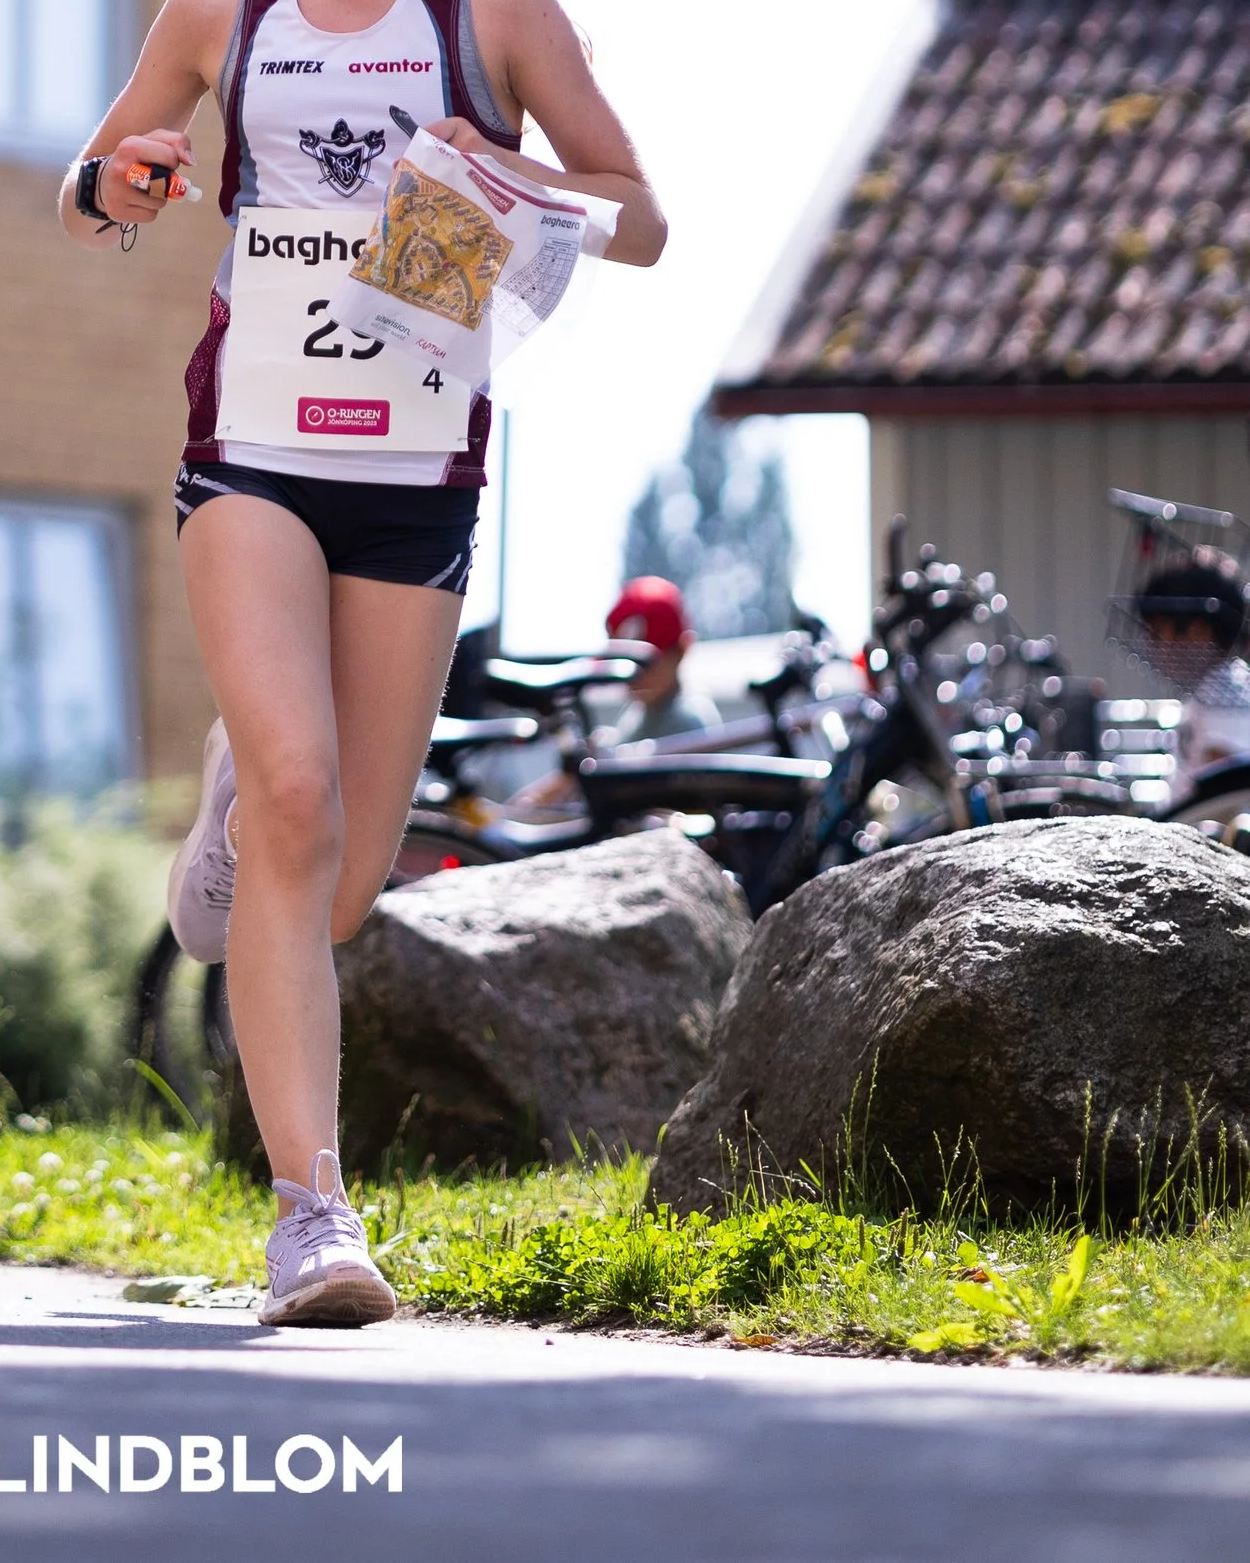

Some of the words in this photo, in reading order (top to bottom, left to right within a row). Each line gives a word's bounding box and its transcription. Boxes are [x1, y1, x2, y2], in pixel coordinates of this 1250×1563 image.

[259, 60, 325, 75] TRIMTEX
[348, 58, 434, 74] avantor
[540, 215, 580, 231] bagheera
[248, 227, 367, 266] baghe
[422, 367, 444, 394] 4
[327, 408, 381, 420] O-RINGEN
